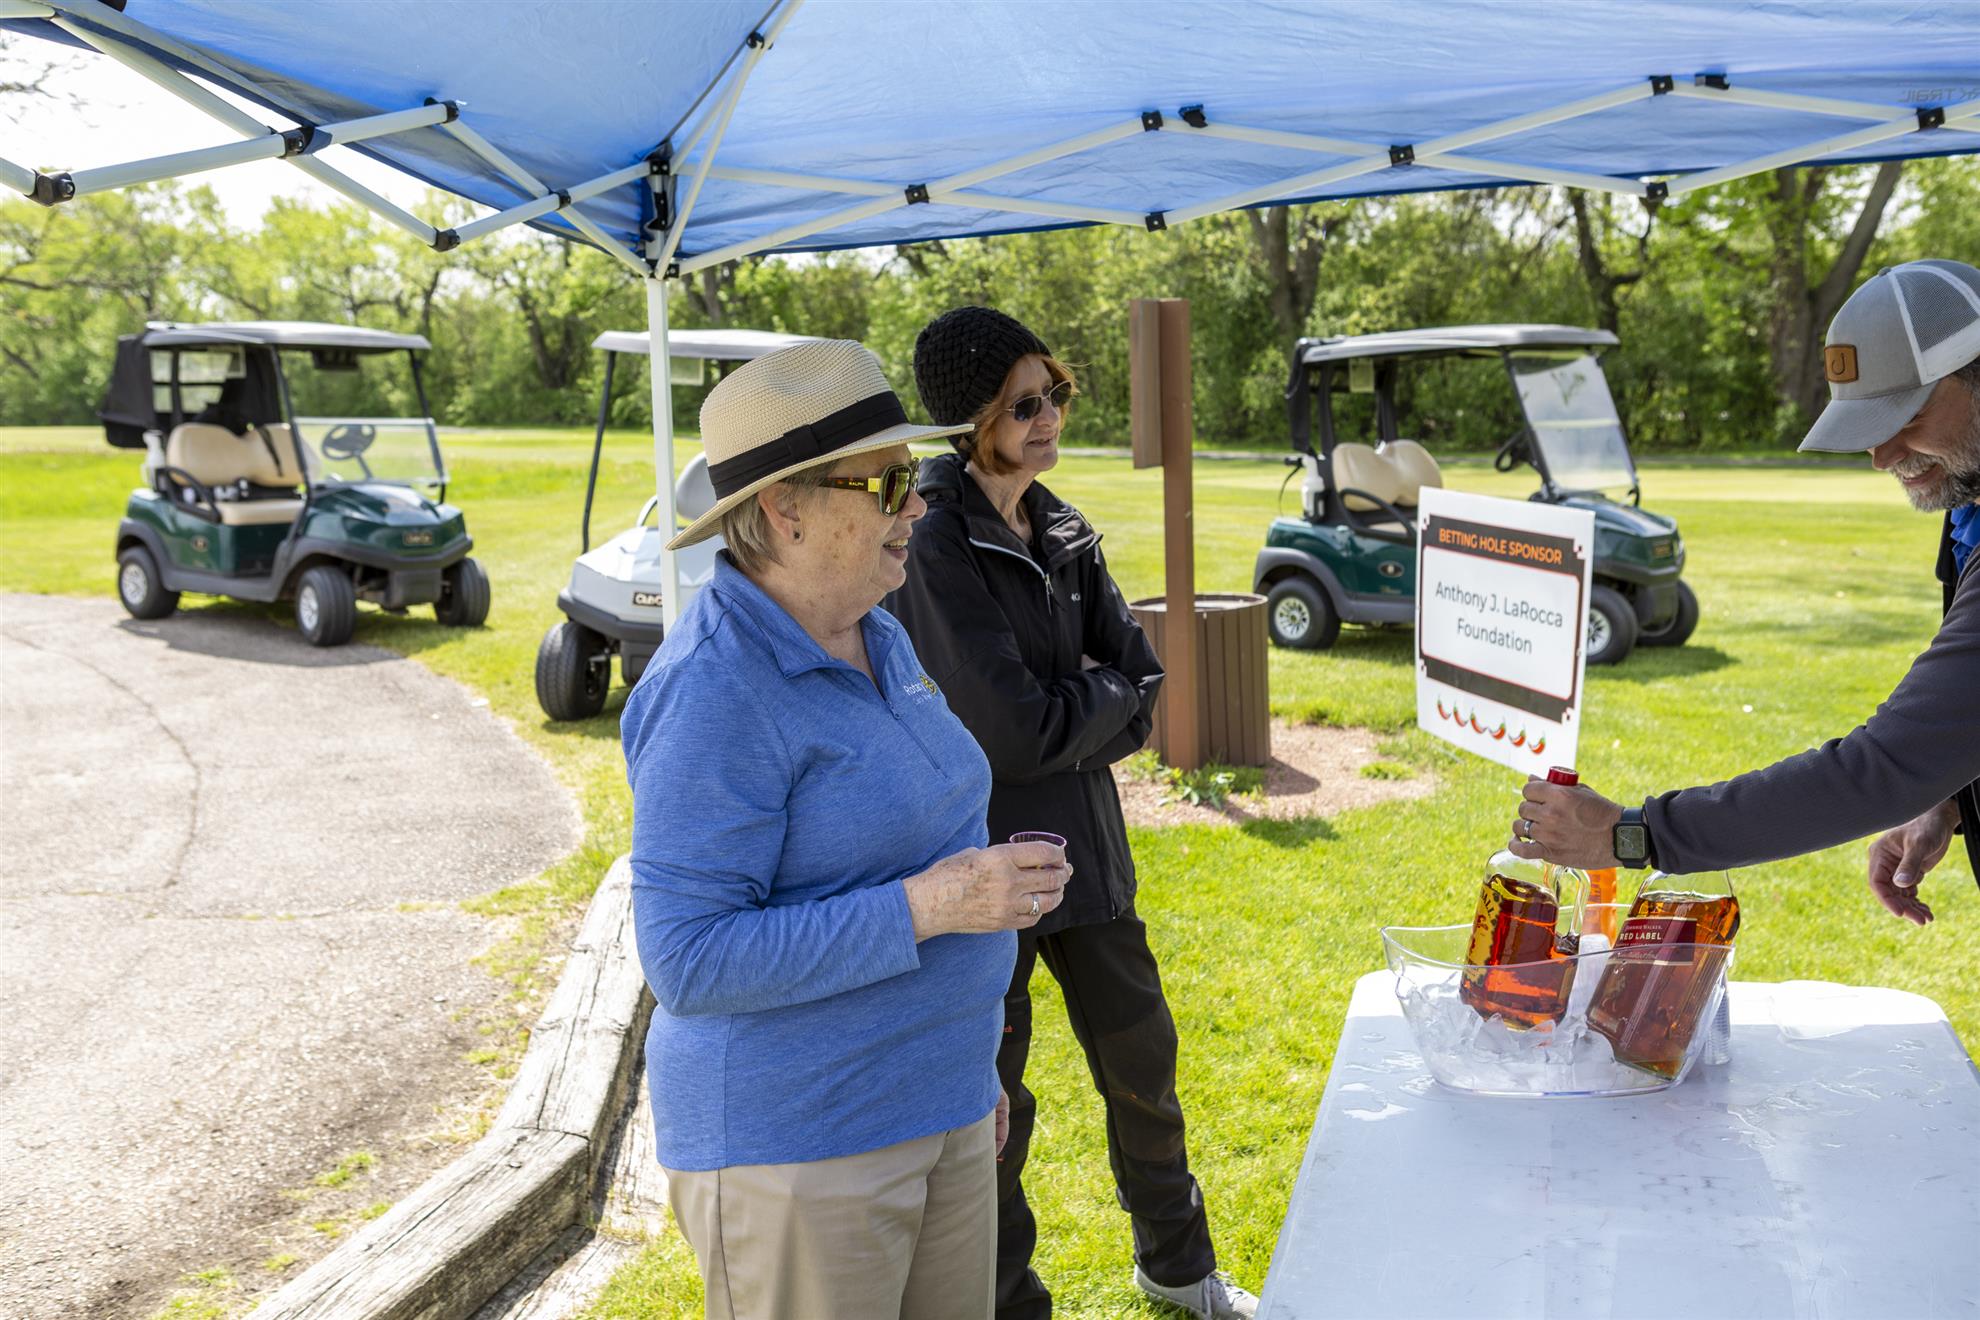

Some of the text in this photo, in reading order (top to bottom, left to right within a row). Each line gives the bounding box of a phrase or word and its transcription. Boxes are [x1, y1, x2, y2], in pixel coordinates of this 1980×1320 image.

[1439, 528, 1562, 565] BETTING HOLE SPONSOR
[1435, 581, 1563, 628] Anthony J. LaRocca
[1457, 617, 1533, 655] Foundation
[903, 682, 927, 698] Rotary
[1619, 931, 1663, 941] RED LABEL
